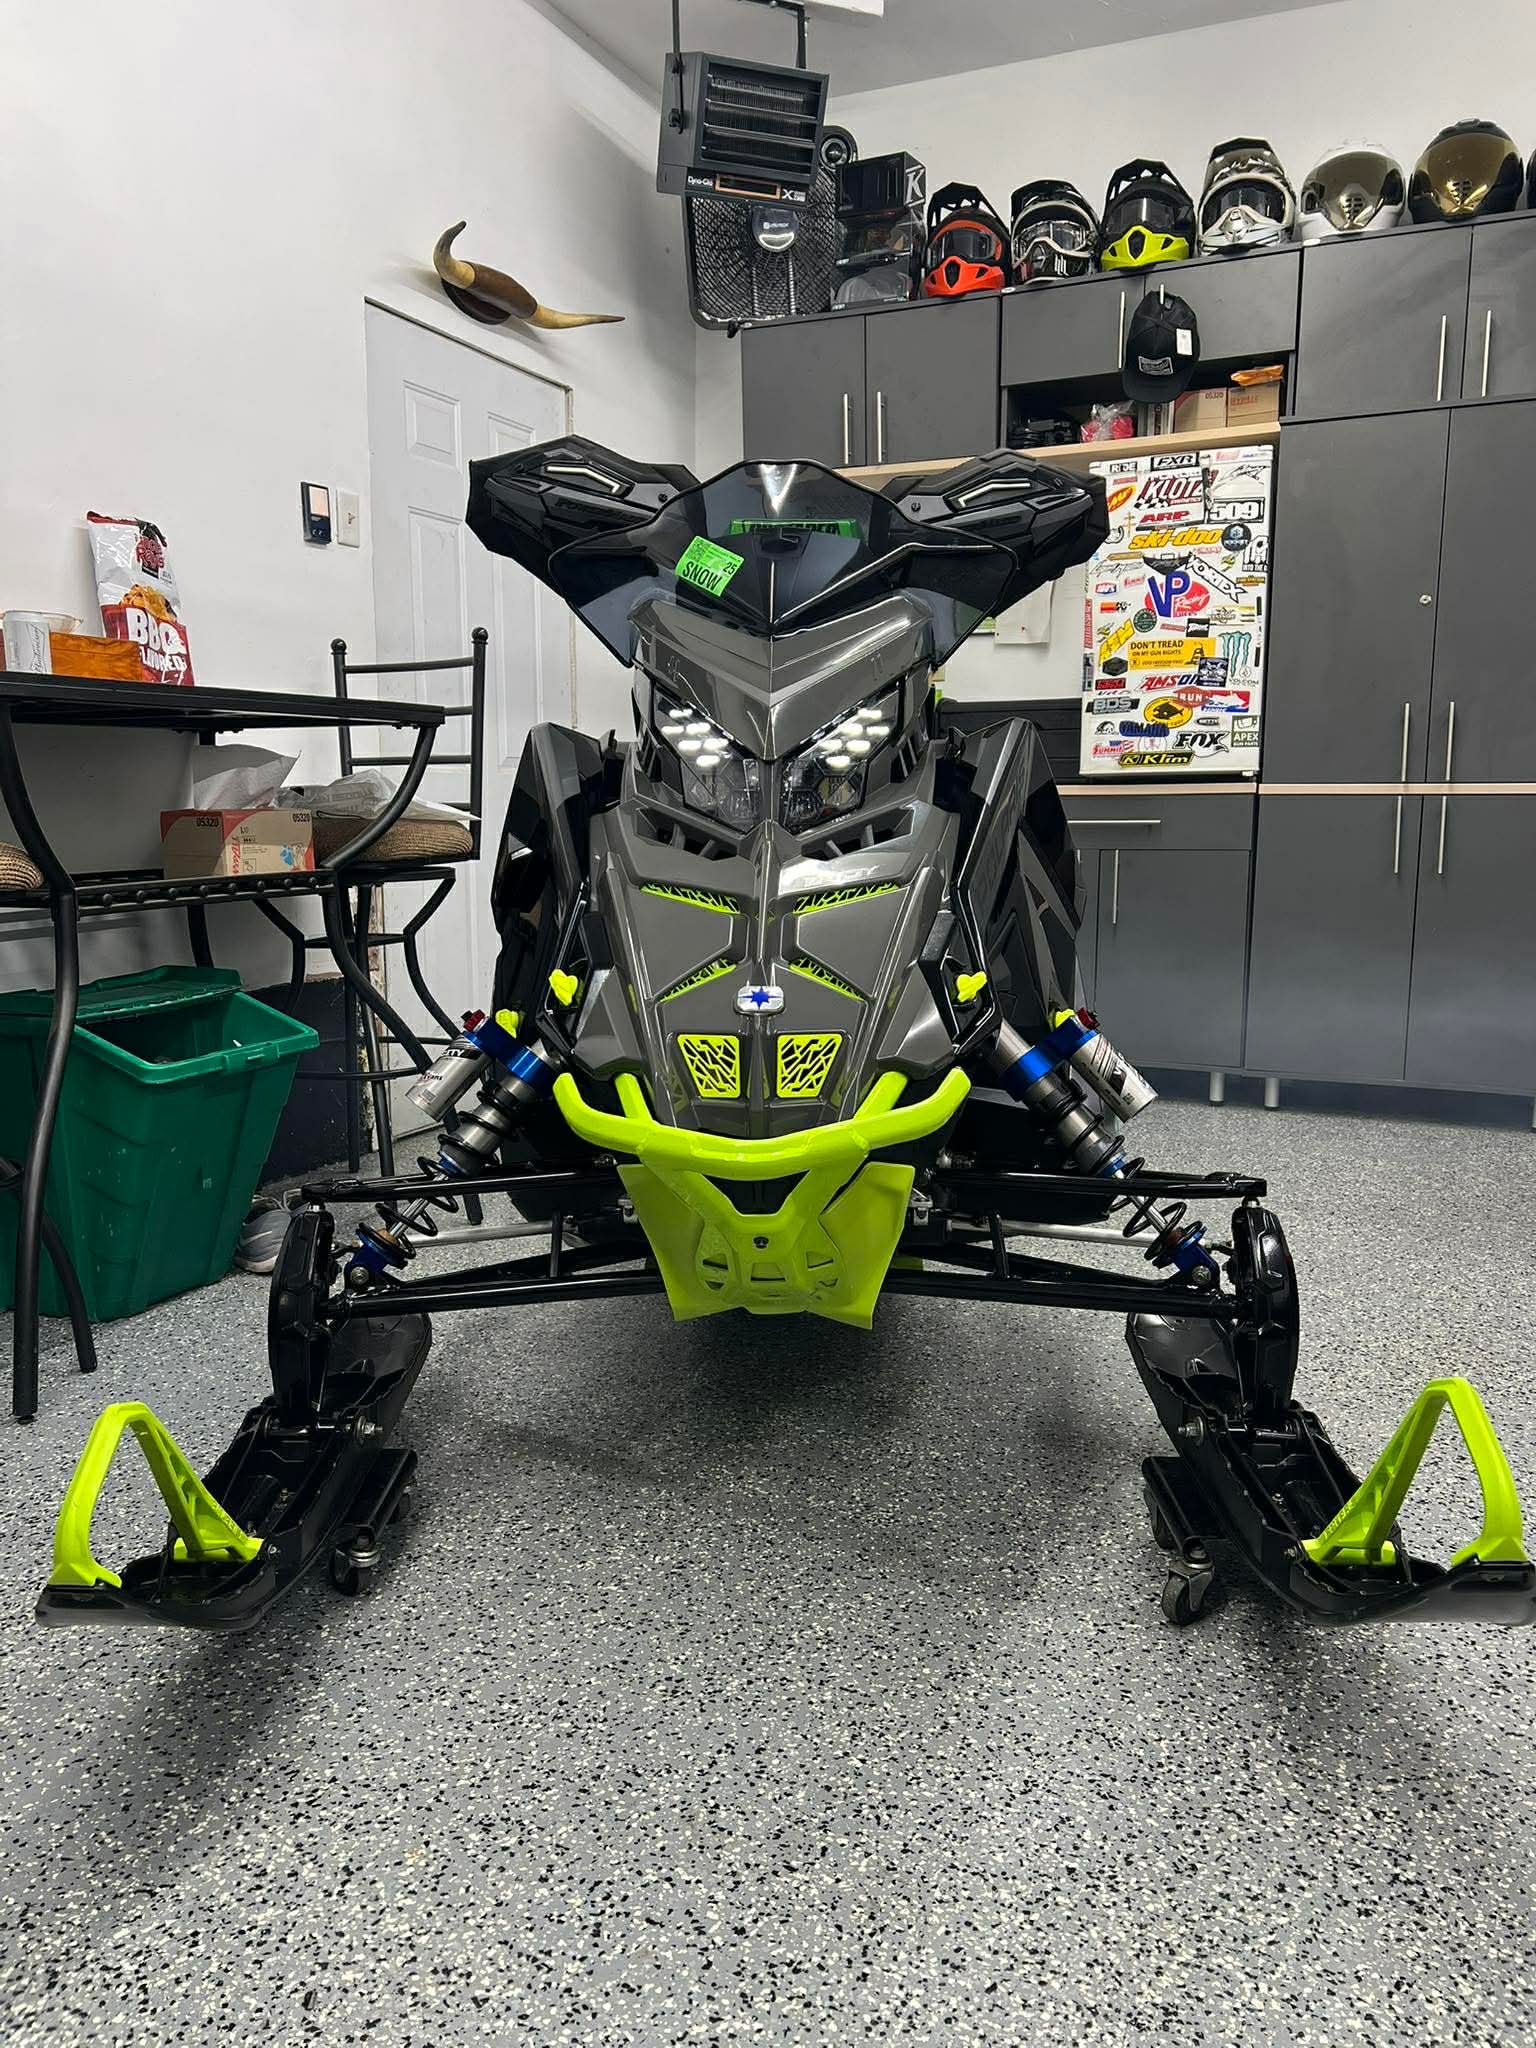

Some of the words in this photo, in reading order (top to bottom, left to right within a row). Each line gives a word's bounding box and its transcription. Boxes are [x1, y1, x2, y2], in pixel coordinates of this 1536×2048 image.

[1157, 455, 1194, 467] FXR
[1140, 510, 1191, 524] ARP
[1209, 502, 1260, 521] 509
[1128, 528, 1224, 550] ski-doo
[682, 561, 722, 591] SNOW
[723, 562, 735, 575] 25
[1185, 551, 1249, 604] VORTEX
[1147, 570, 1190, 618] VP
[126, 607, 188, 655] BBQ
[1130, 641, 1155, 650] DON'T
[1157, 640, 1184, 649] TREAD
[138, 645, 188, 673] LAVORED
[1093, 696, 1132, 710] BDS
[1174, 732, 1227, 749] FOX
[1234, 732, 1259, 741] APEX
[196, 817, 219, 828] 05320
[292, 813, 310, 823] 05320
